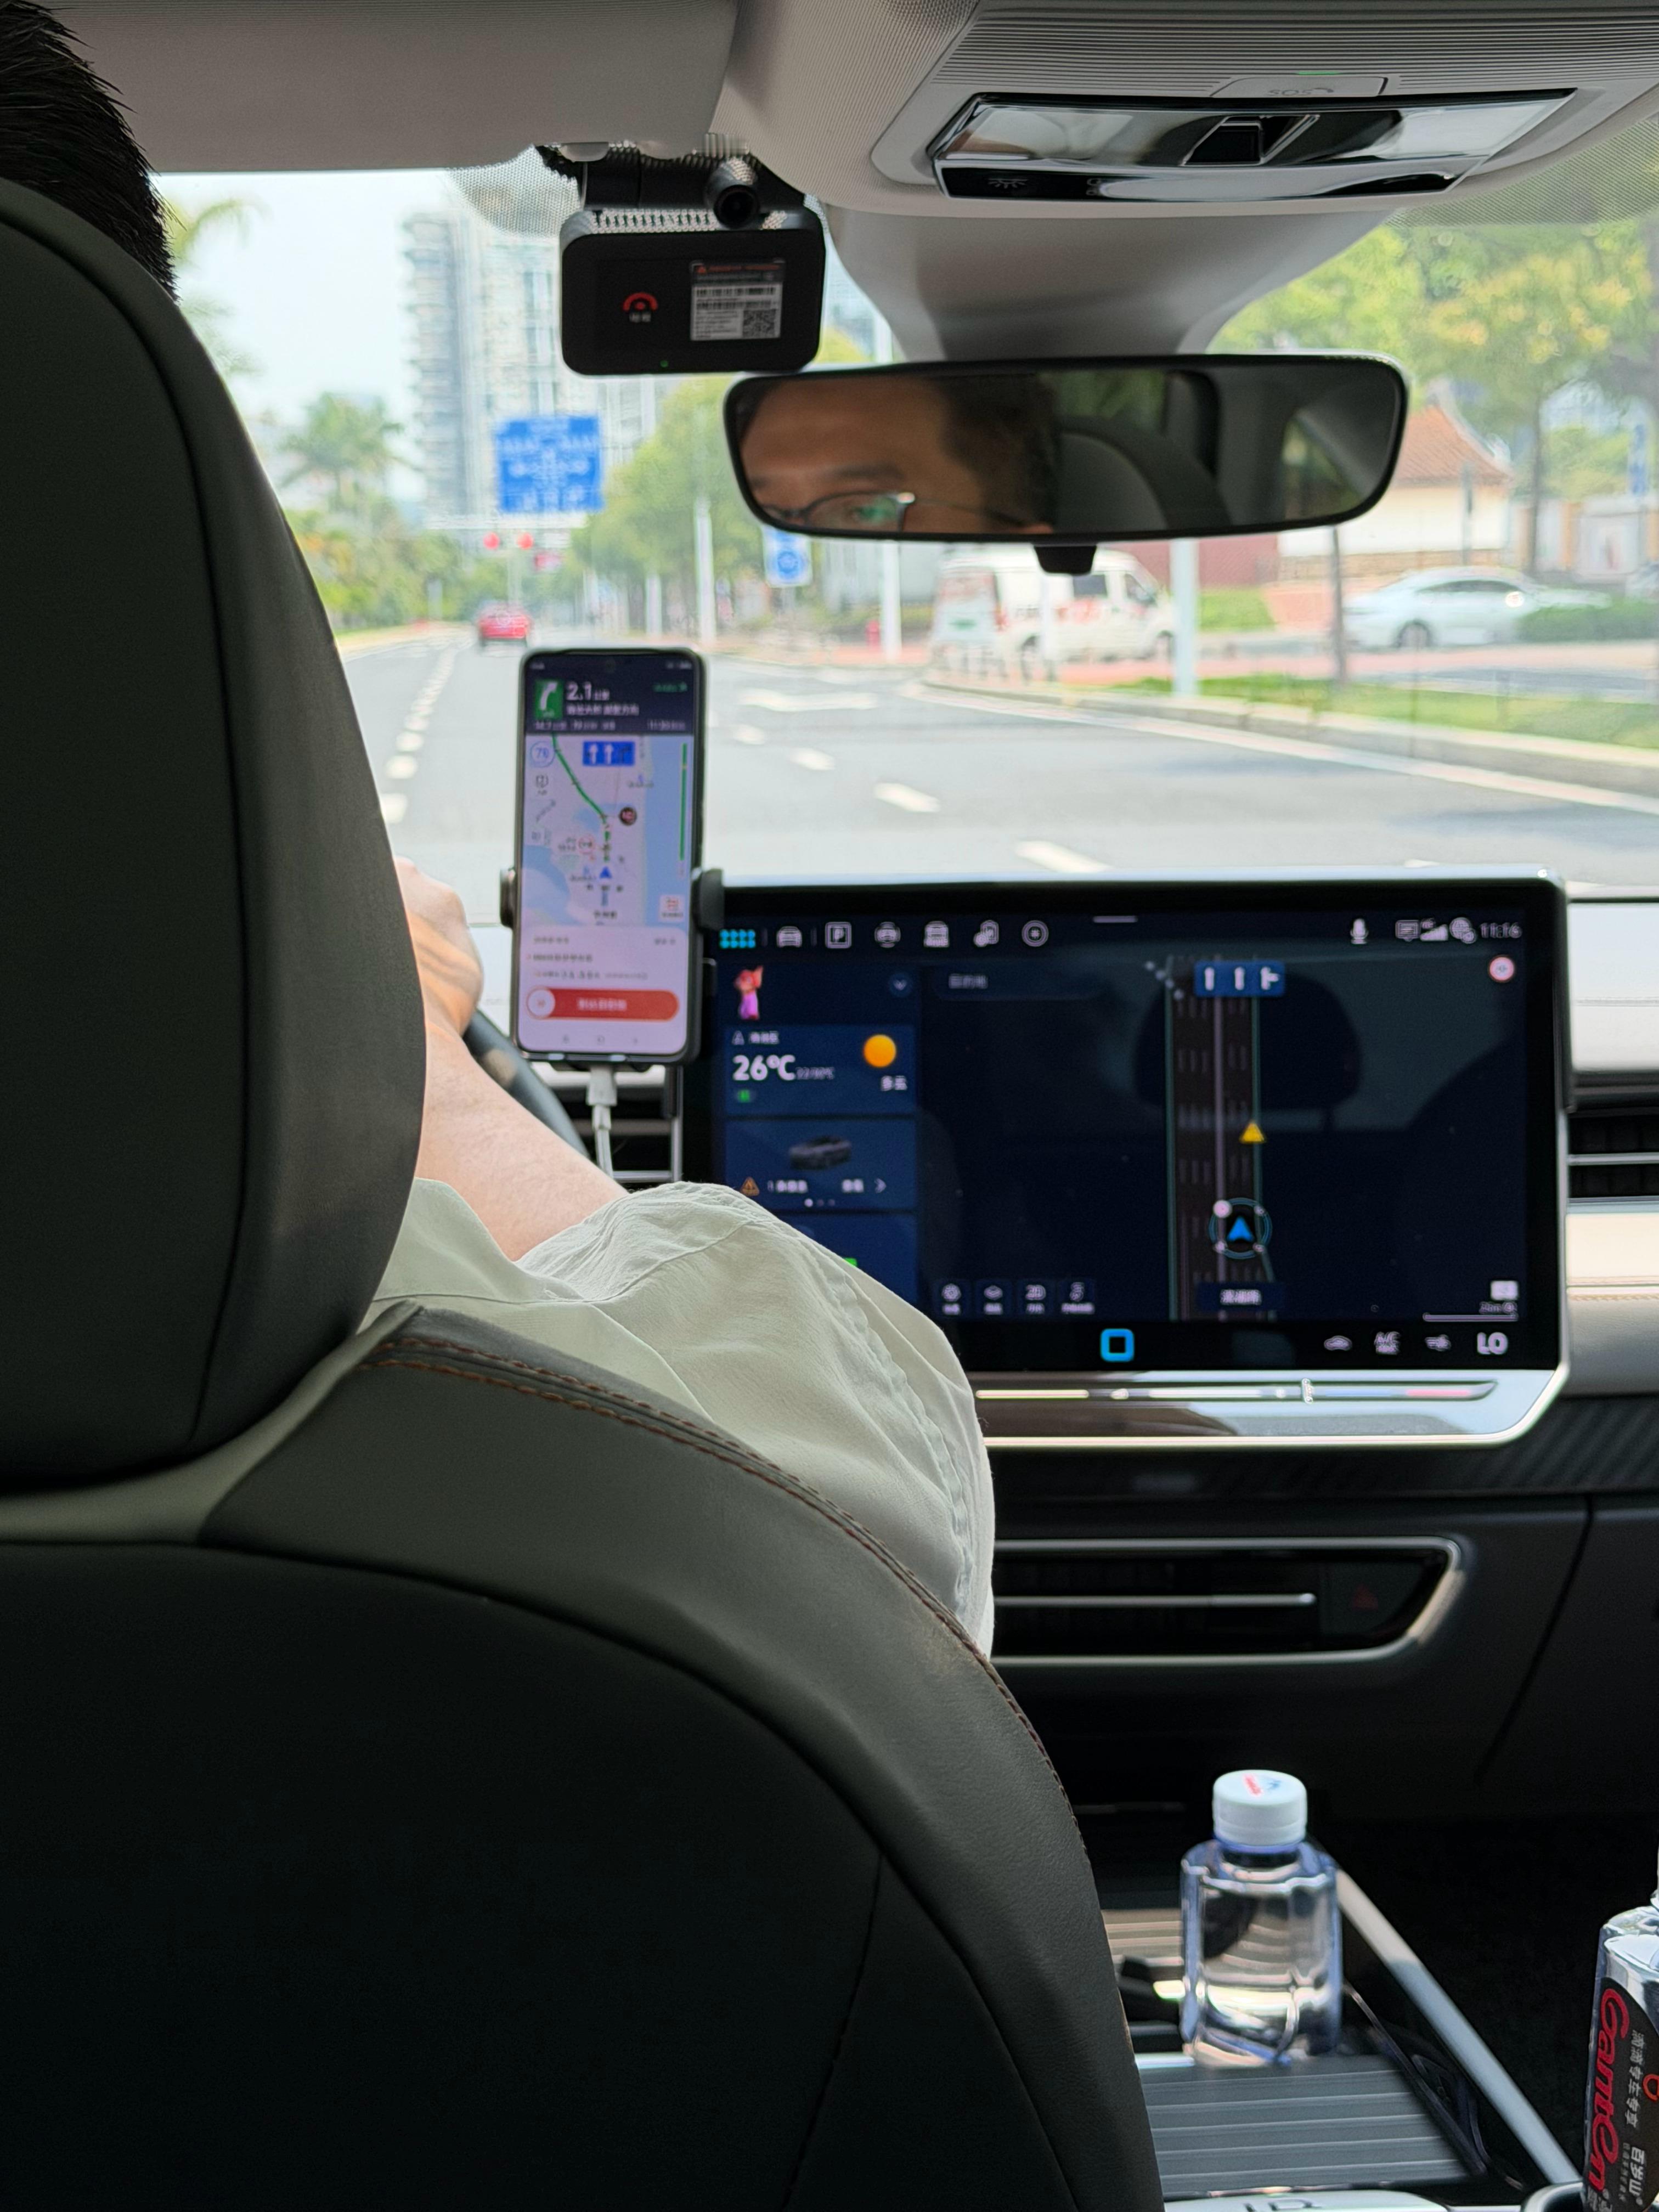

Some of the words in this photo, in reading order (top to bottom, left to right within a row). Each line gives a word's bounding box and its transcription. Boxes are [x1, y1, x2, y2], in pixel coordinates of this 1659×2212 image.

[1476, 1331, 1509, 1355] LO
[1624, 2029, 1645, 2129] 滴滴专车专享
[1628, 2146, 1645, 2197] 百岁山
